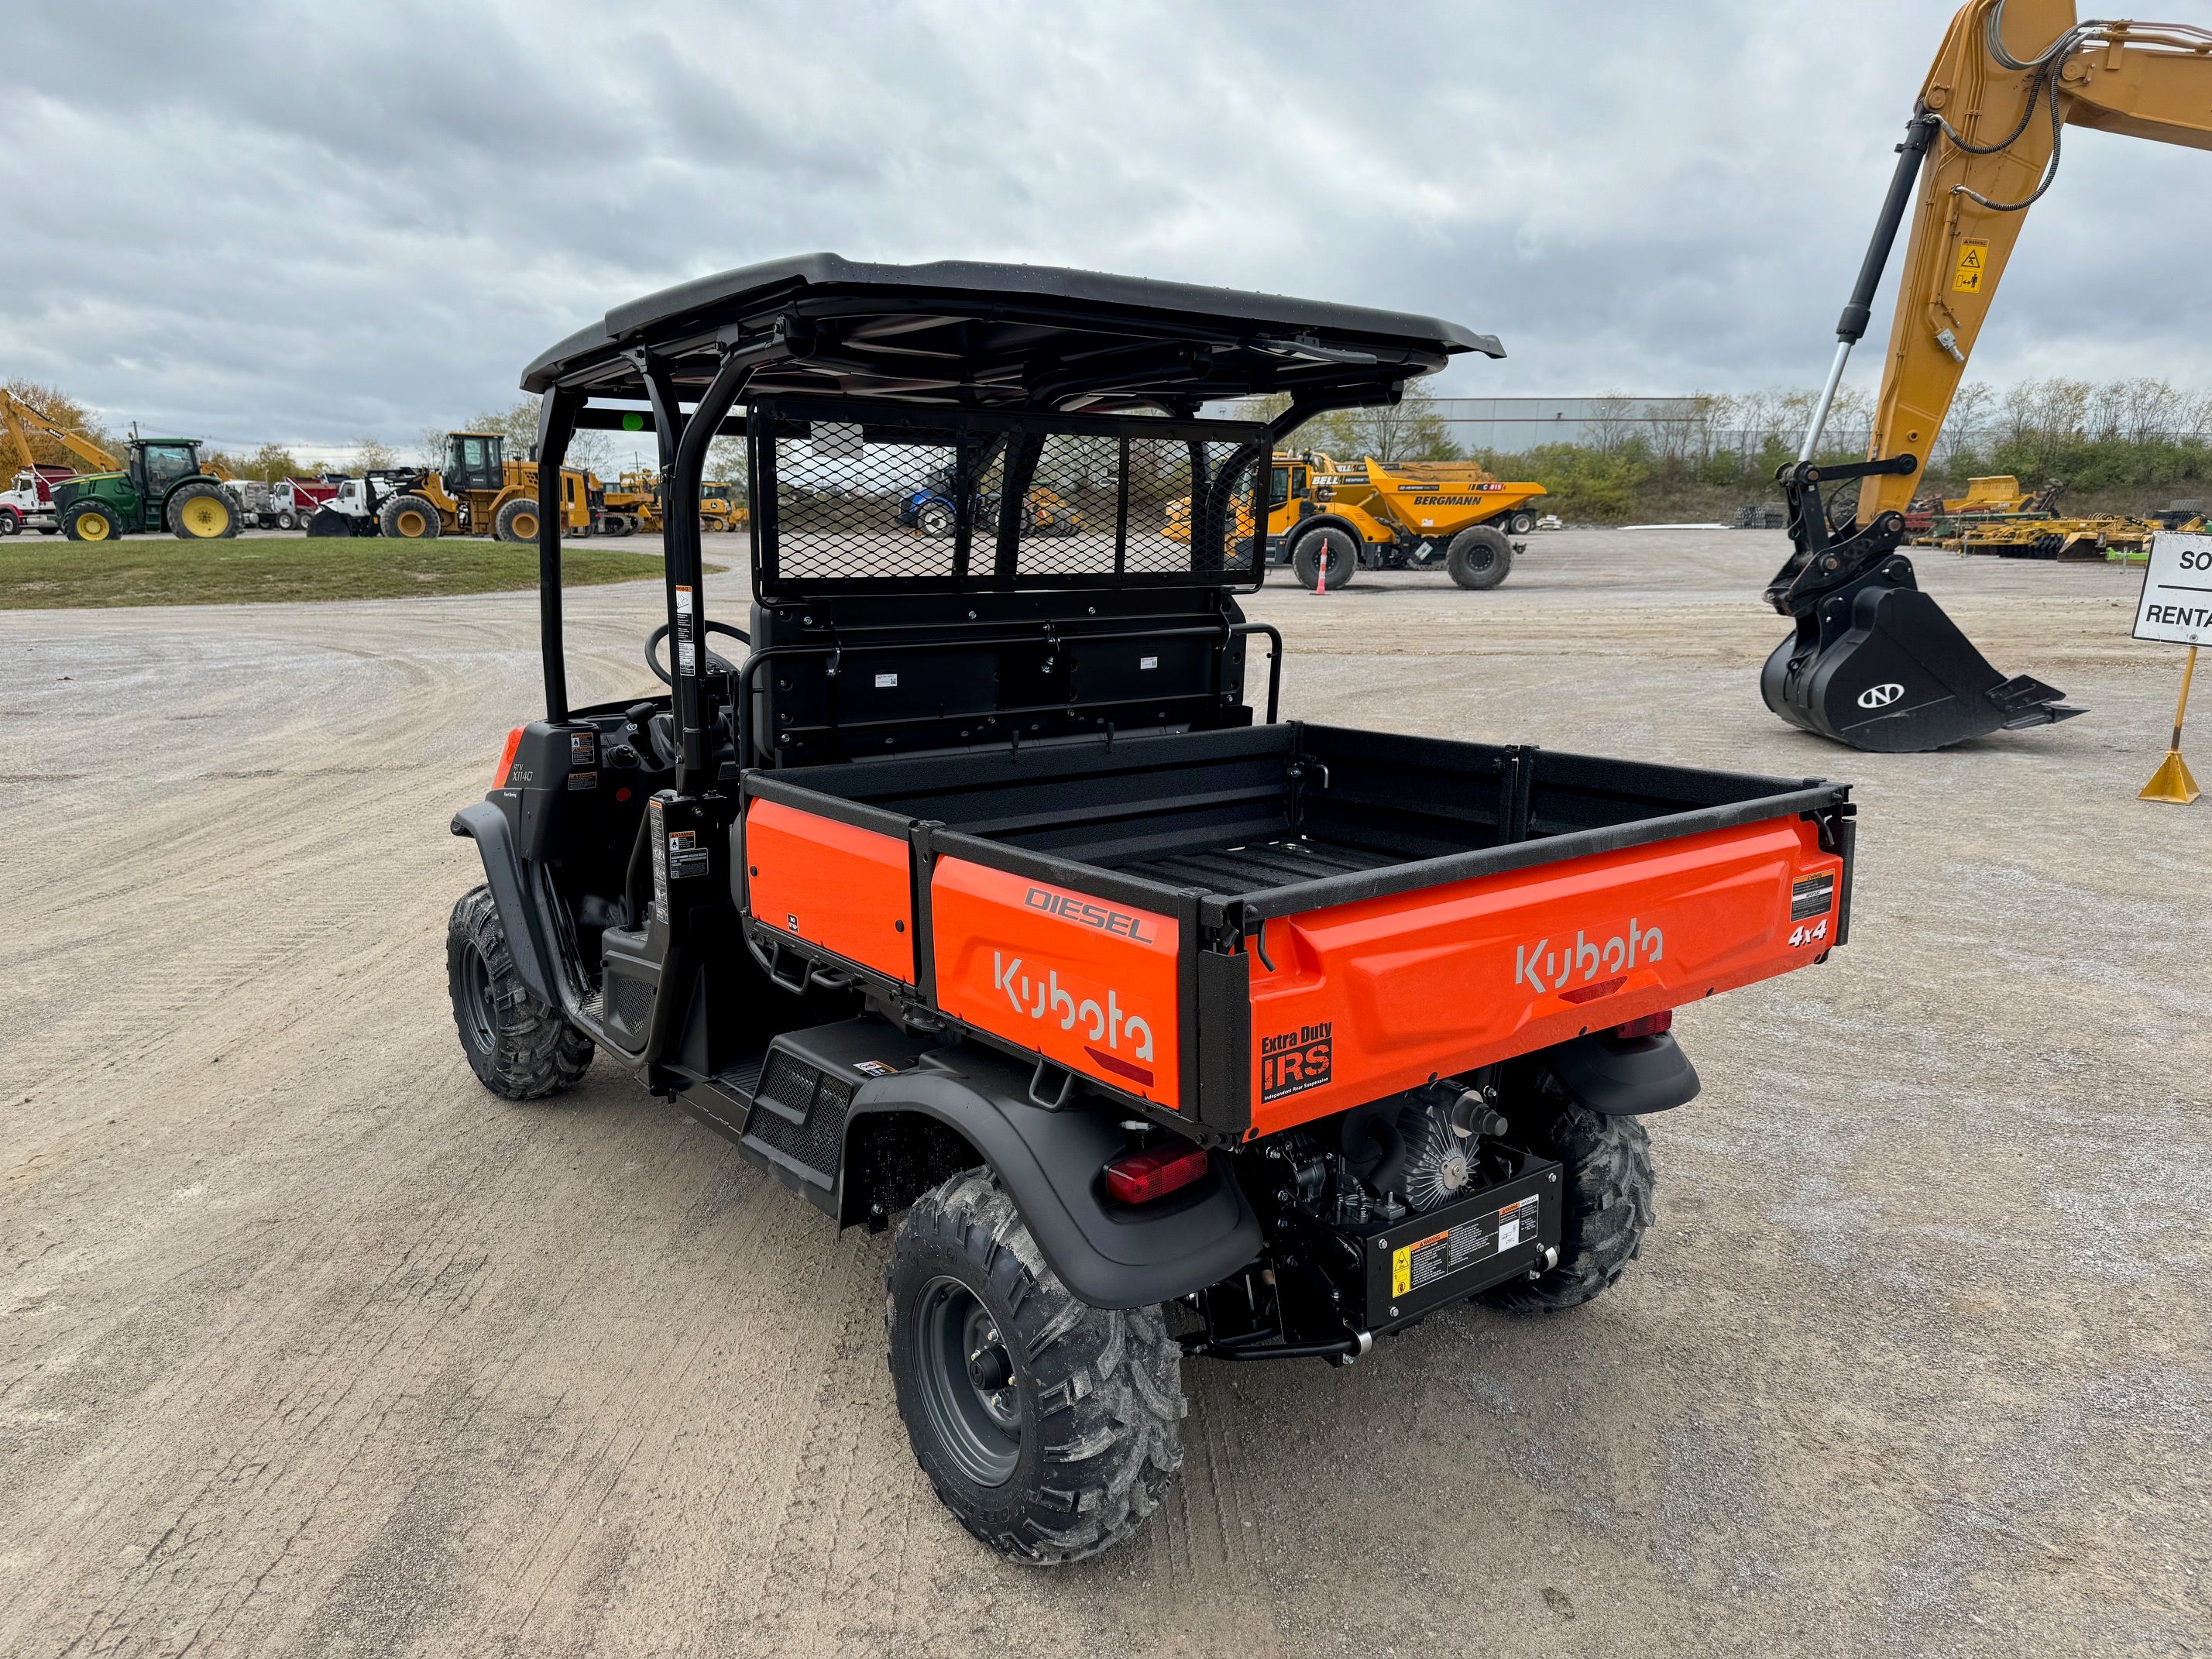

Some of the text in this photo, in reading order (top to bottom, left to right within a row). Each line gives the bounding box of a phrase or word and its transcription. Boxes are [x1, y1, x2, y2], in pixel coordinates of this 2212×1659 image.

[1311, 476, 1339, 486] BELL
[1414, 496, 1482, 506] BERGMANN
[1025, 887, 1154, 945] DIESEL
[1788, 919, 1828, 947] 4x4
[1514, 917, 1663, 994] Kubota
[994, 951, 1153, 1063] Kubota
[1262, 1022, 1332, 1055] Extra Duty
[1264, 1044, 1330, 1091] IRS
[1263, 1088, 1293, 1101] Independent
[1304, 1077, 1329, 1089] Suspension
[1424, 1235, 1441, 1245] WARNING
